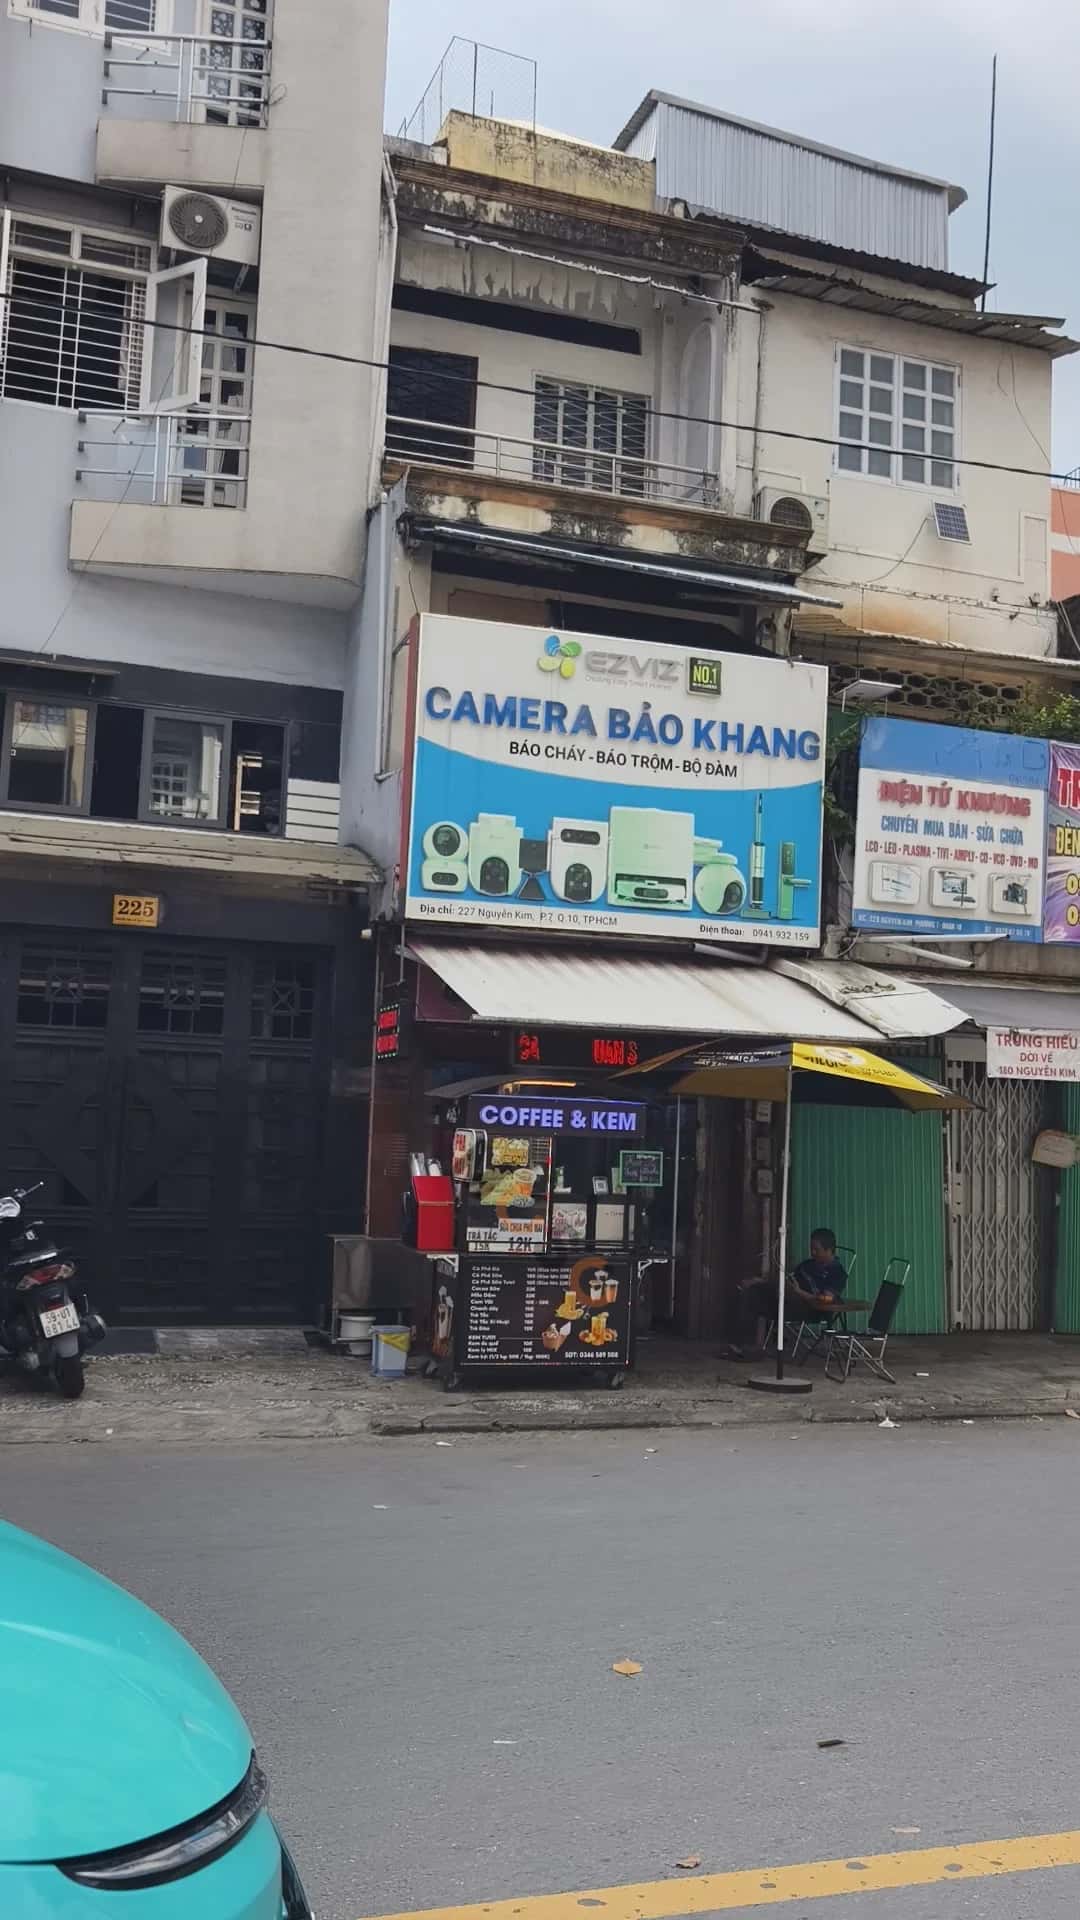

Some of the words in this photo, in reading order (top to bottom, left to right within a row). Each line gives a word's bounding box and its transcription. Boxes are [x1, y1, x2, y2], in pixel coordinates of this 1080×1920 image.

[585, 651, 680, 682] EZVIZ
[693, 665, 716, 684] NO.1
[425, 686, 598, 737] CAMERA
[608, 701, 684, 746] BẢO
[692, 718, 821, 762] KHANG
[509, 739, 541, 757] BÁO
[544, 744, 586, 762] CHÁY
[596, 749, 627, 766] BÁO
[631, 754, 673, 773] TRỘM
[682, 759, 702, 776] BỘ
[705, 760, 738, 778] ĐÀM
[924, 819, 945, 836] MUA
[949, 820, 968, 840] BÁN
[865, 840, 878, 852] LCD
[884, 842, 896, 854] LED
[902, 844, 931, 857] PLASMA
[118, 899, 154, 917] 225
[458, 907, 476, 915] 227
[584, 916, 617, 926] TPHCM
[1047, 1033, 1078, 1049] HIẾU
[1059, 1068, 1076, 1078] KIM
[479, 1105, 564, 1128] COFFEE
[570, 1110, 587, 1128] &
[591, 1111, 637, 1131] KEM
[508, 1236, 532, 1252] 12K
